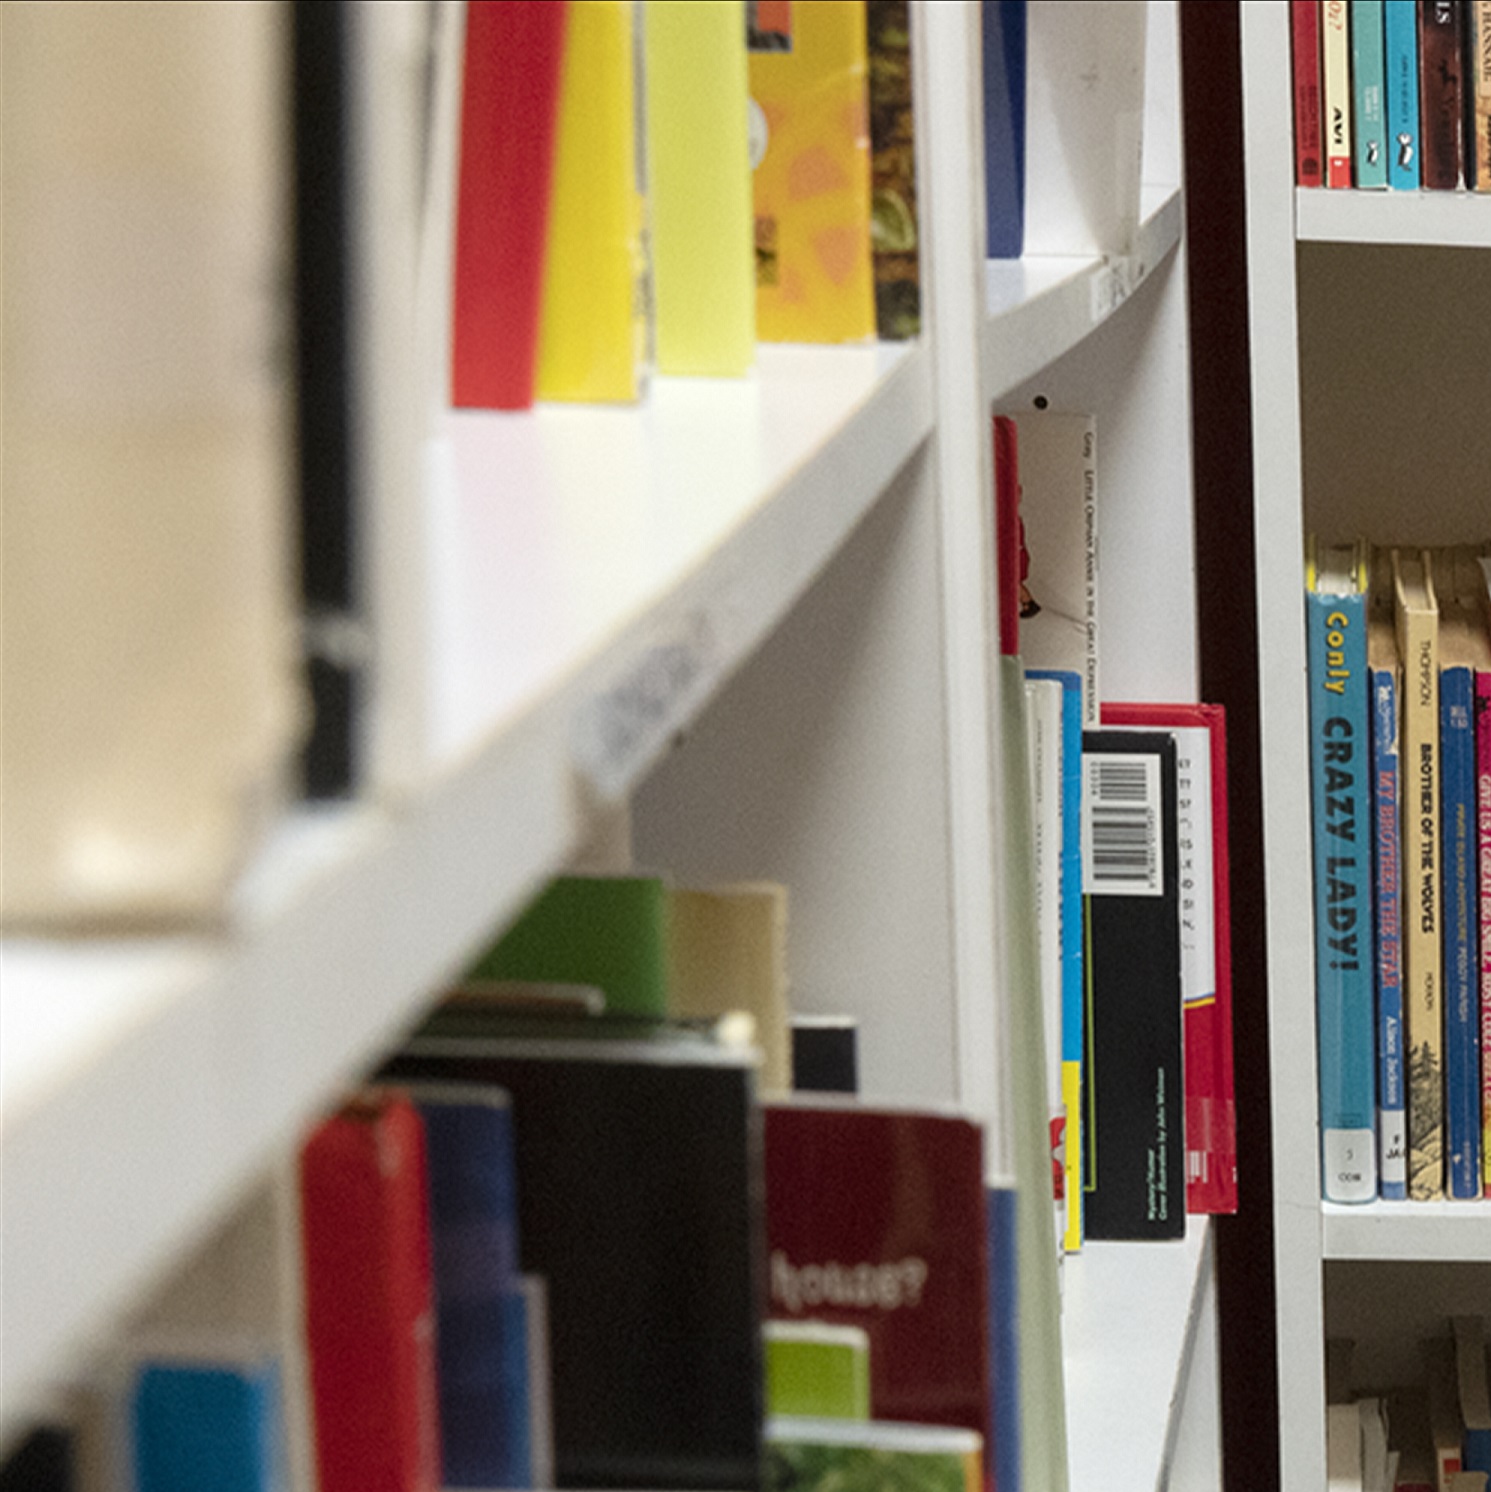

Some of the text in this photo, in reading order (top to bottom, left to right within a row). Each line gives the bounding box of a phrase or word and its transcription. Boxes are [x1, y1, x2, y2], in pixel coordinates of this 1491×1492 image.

[1334, 107, 1343, 145] AVI
[1325, 612, 1349, 695] Conly
[1324, 717, 1360, 970] CRAZY LADY!
[1420, 743, 1437, 935] BROTHER OF THE WOLVES
